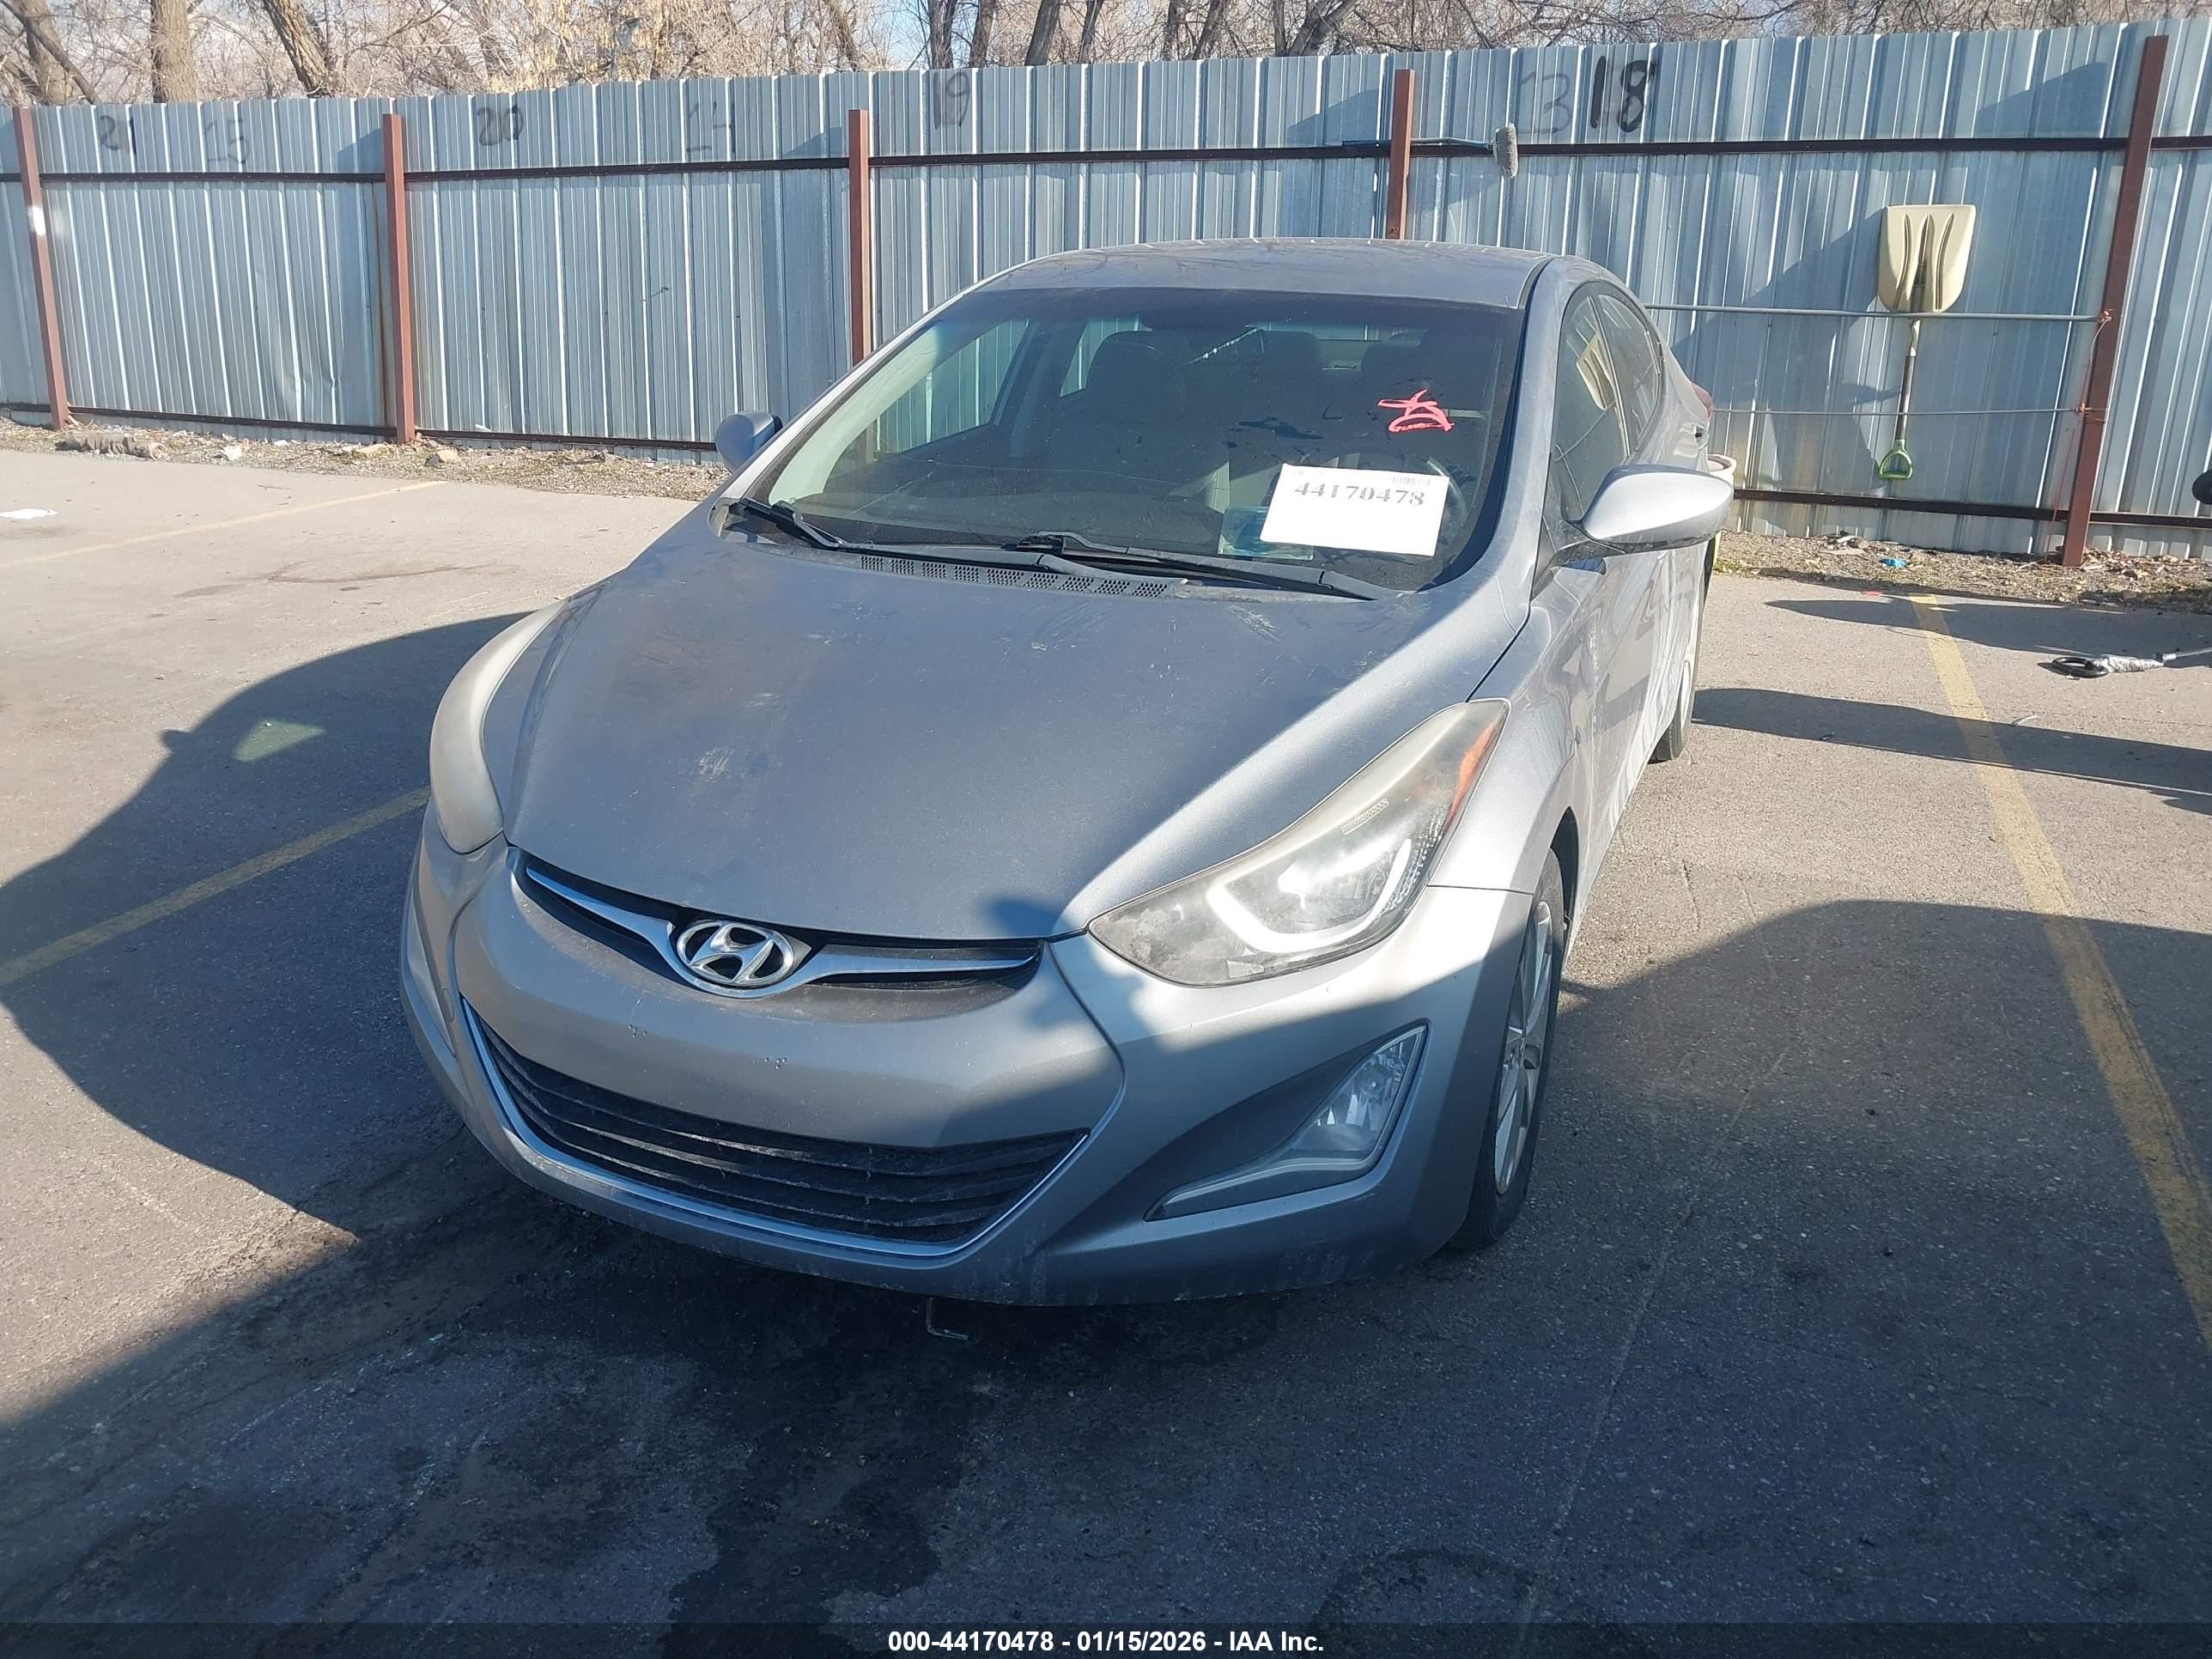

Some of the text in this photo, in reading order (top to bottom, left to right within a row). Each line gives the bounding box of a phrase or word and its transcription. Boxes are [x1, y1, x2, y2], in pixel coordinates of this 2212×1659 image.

[933, 71, 970, 131] 19
[1589, 55, 1656, 133] 18
[100, 114, 138, 156] 21
[477, 104, 524, 146] 20
[1294, 482, 1425, 507] 44170478
